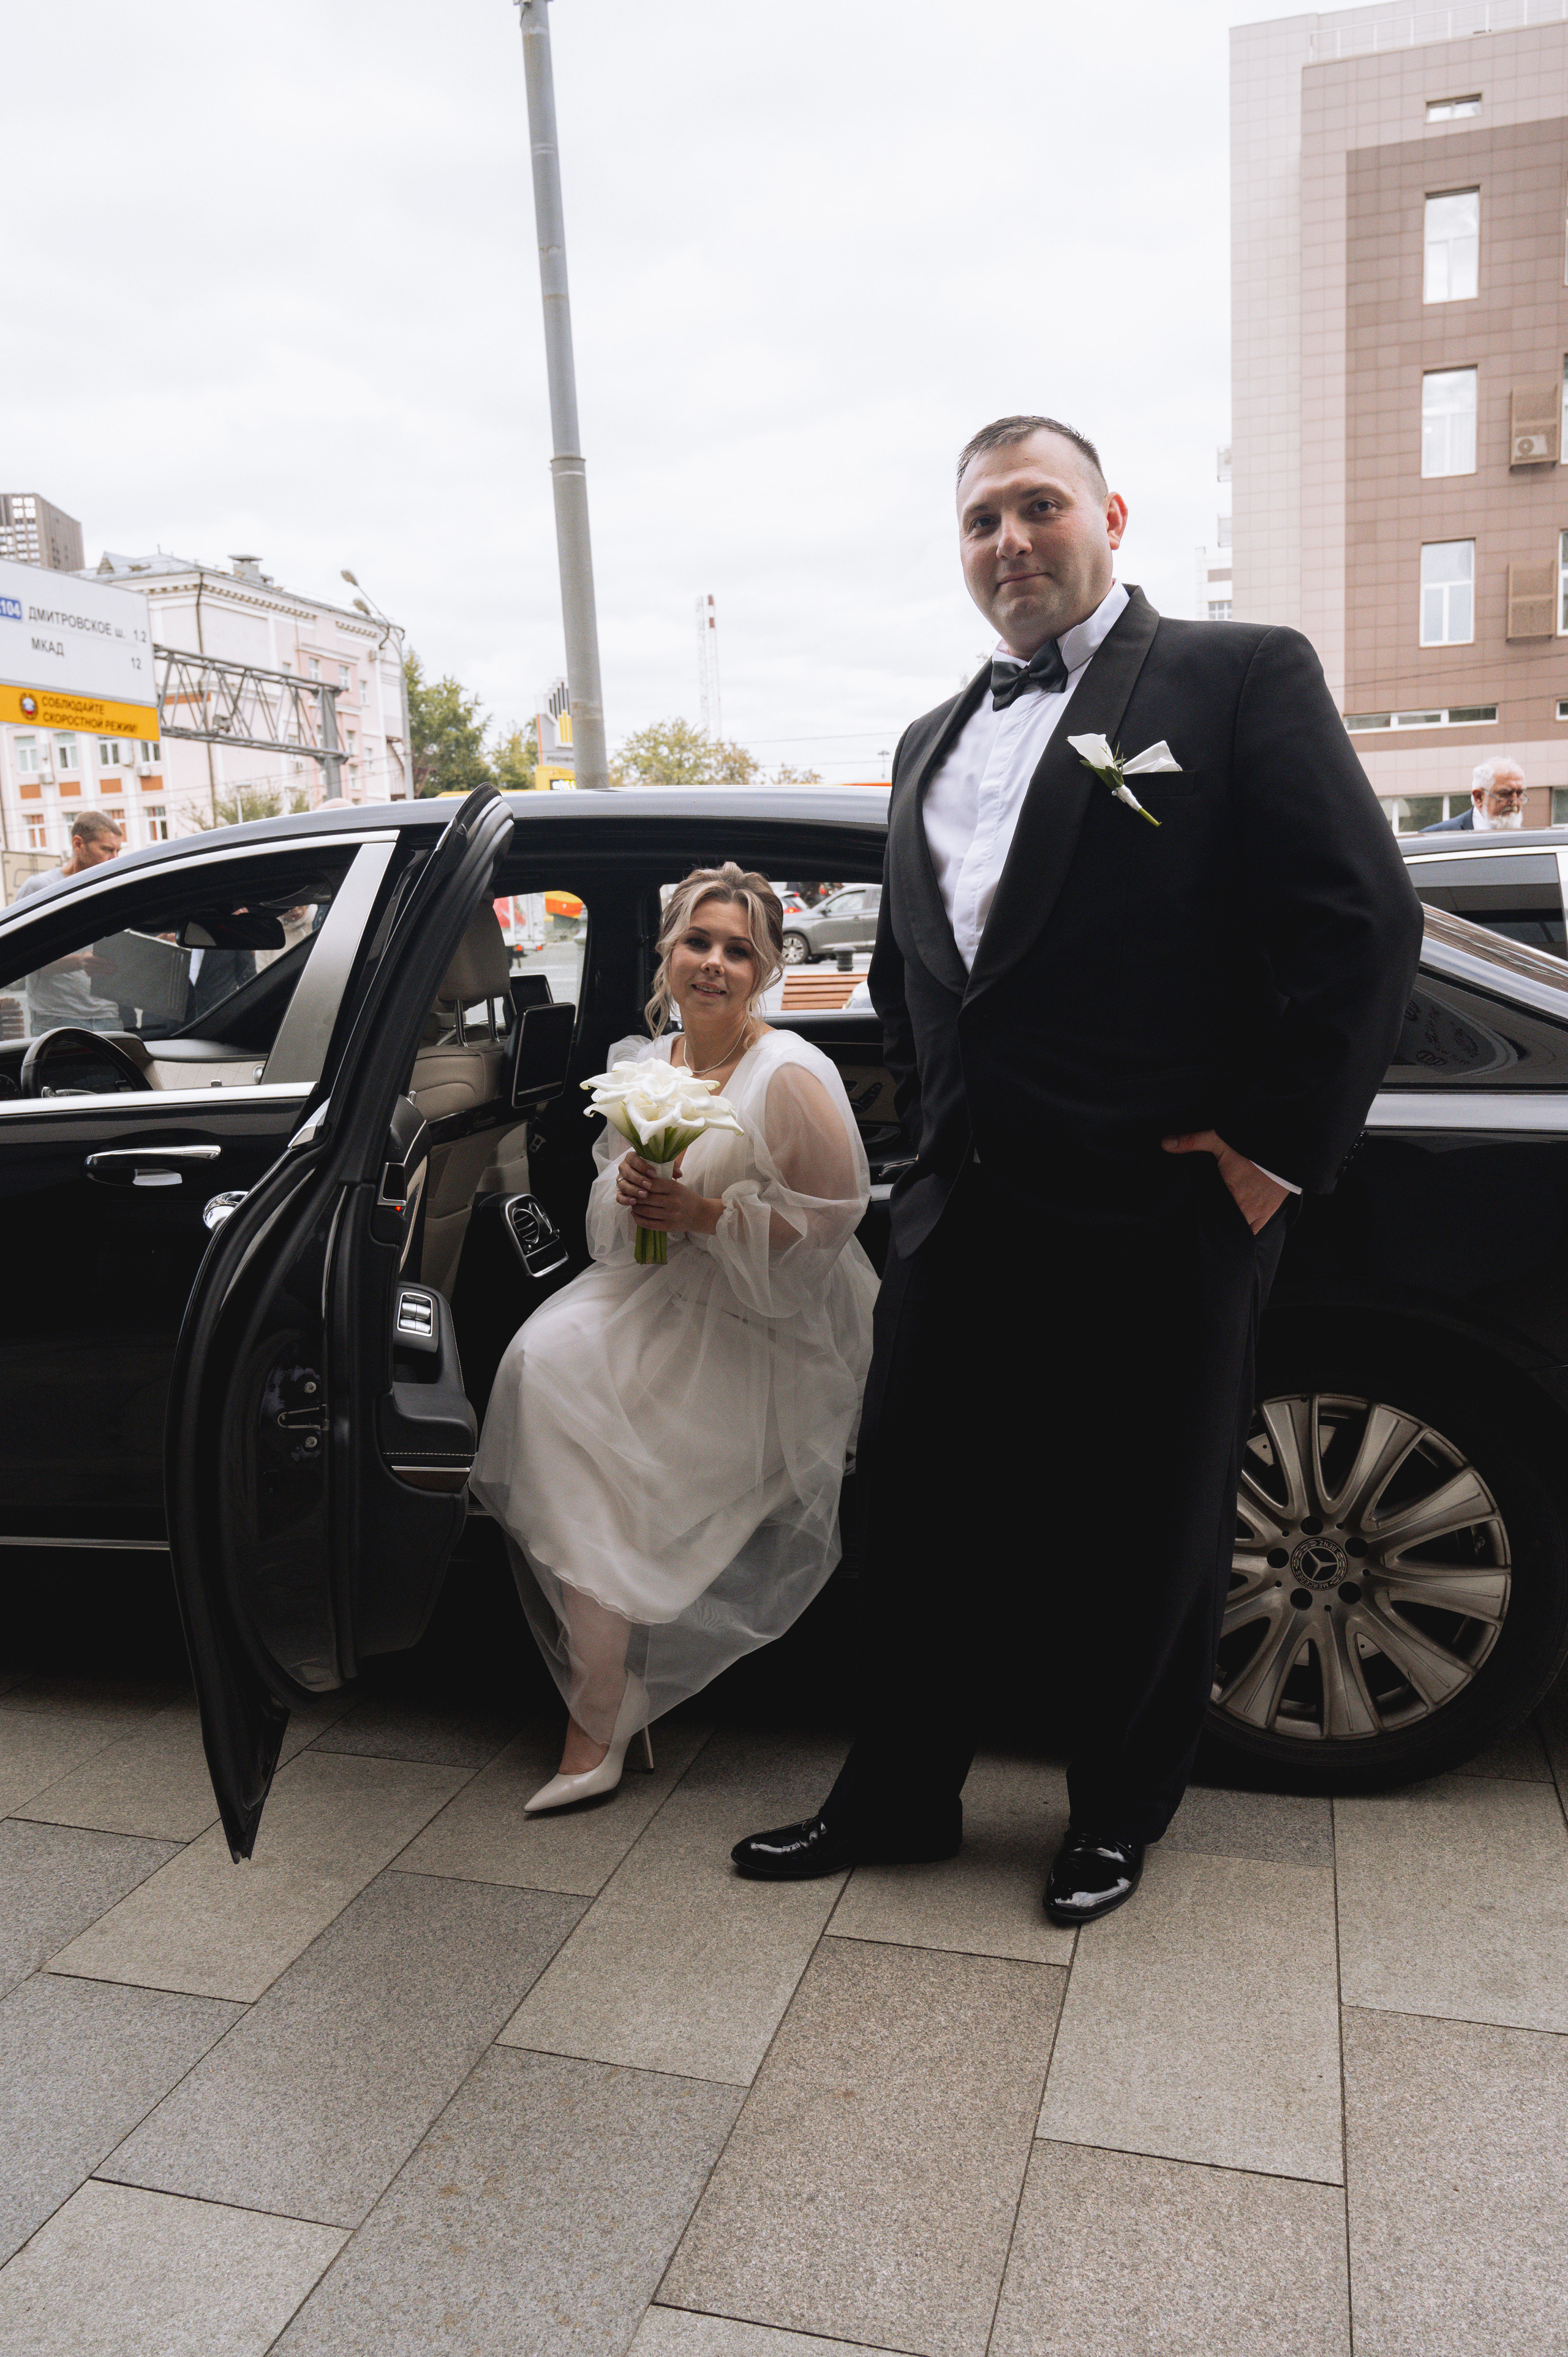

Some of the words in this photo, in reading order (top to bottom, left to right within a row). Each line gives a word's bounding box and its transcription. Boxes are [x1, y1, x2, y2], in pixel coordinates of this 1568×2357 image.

[0, 599, 20, 618] 104
[29, 606, 111, 635] ДМИТРОВСКОЕ
[134, 629, 146, 643] 1.2
[31, 637, 64, 657] МКАД
[131, 657, 141, 670] 12
[42, 696, 104, 716] СОБЛЮДАЙТЕ
[43, 711, 104, 728] СКОРОСТНОЙ
[1319, 1540, 1337, 1551] BENZ
[1295, 1570, 1329, 1588] MERCEDES
